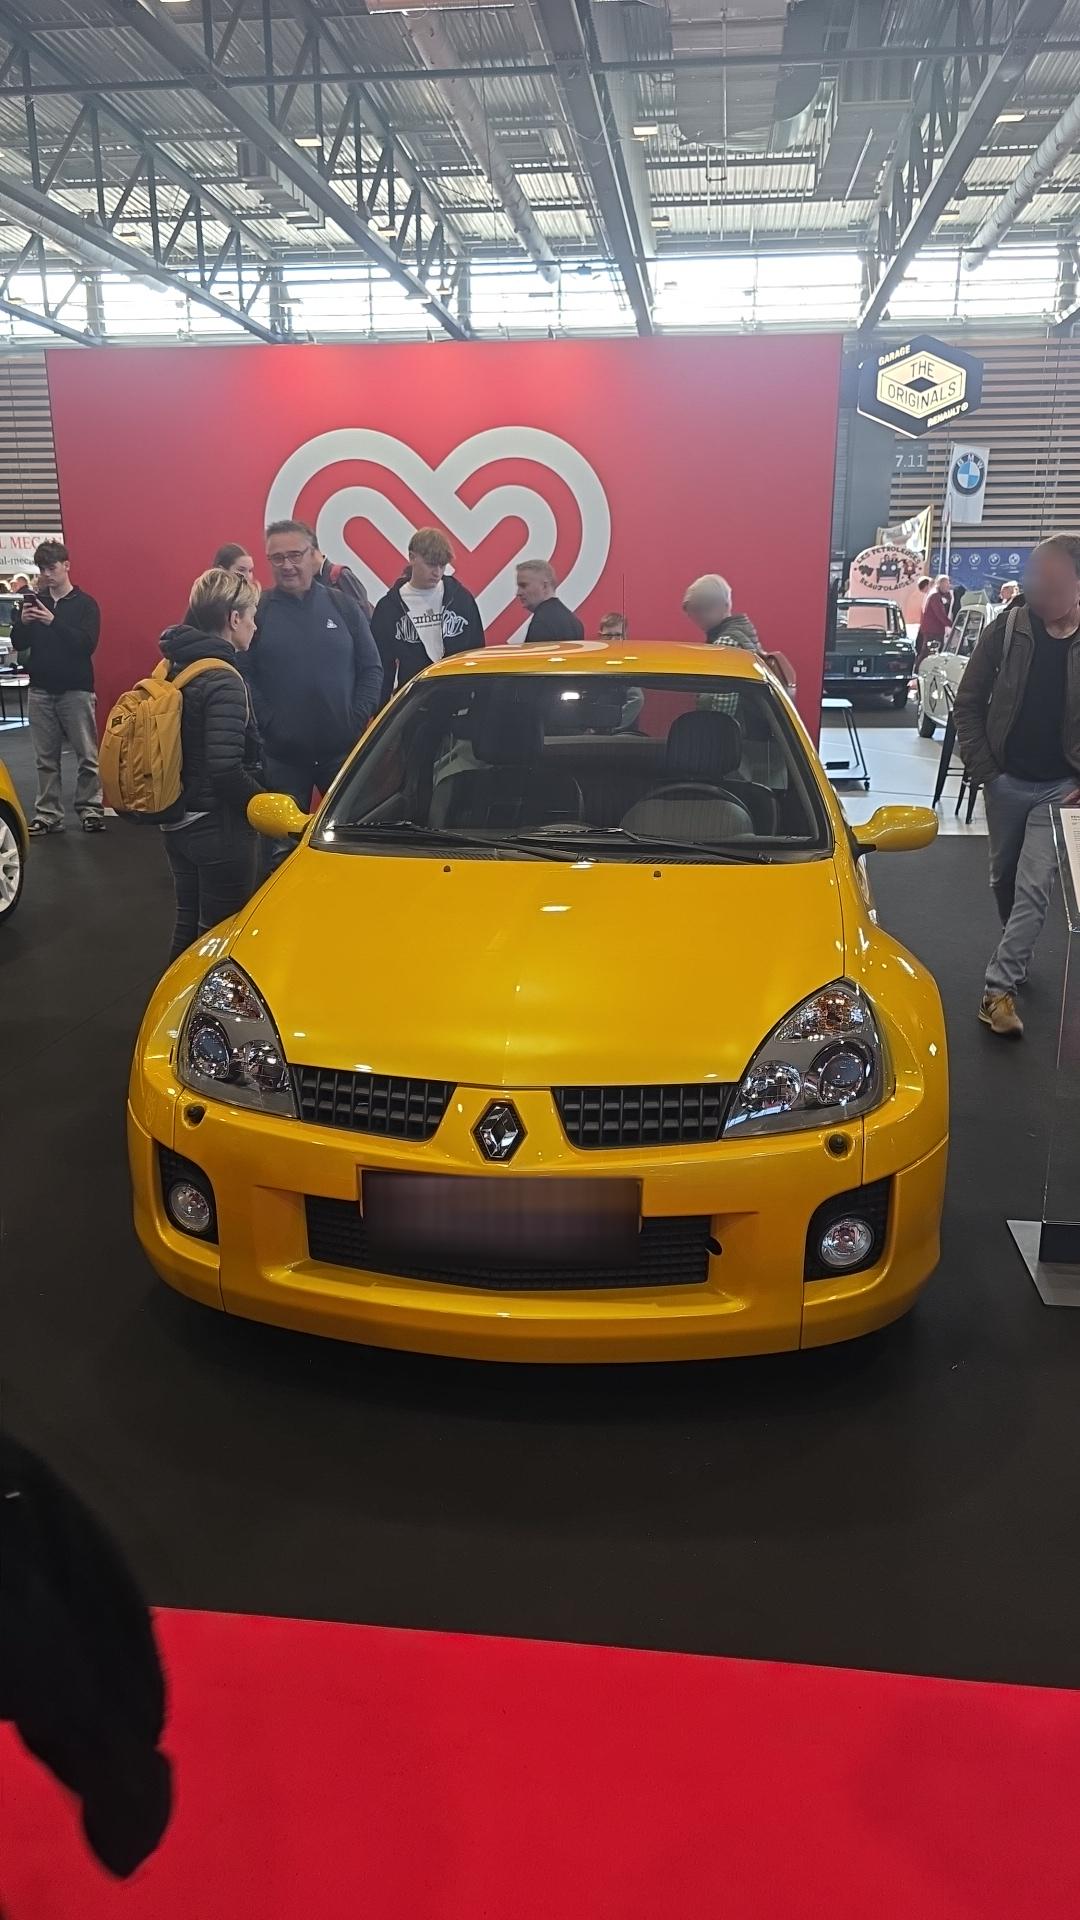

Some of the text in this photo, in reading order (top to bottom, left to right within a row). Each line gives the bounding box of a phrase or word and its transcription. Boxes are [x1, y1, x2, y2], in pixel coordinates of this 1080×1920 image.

[878, 345, 911, 366] GARAGE
[910, 360, 935, 379] THE
[887, 381, 957, 409] ORIGINALS
[927, 404, 961, 428] RENAULT
[895, 454, 925, 468] 7.11
[956, 453, 985, 469] BMW
[856, 551, 871, 564] LES
